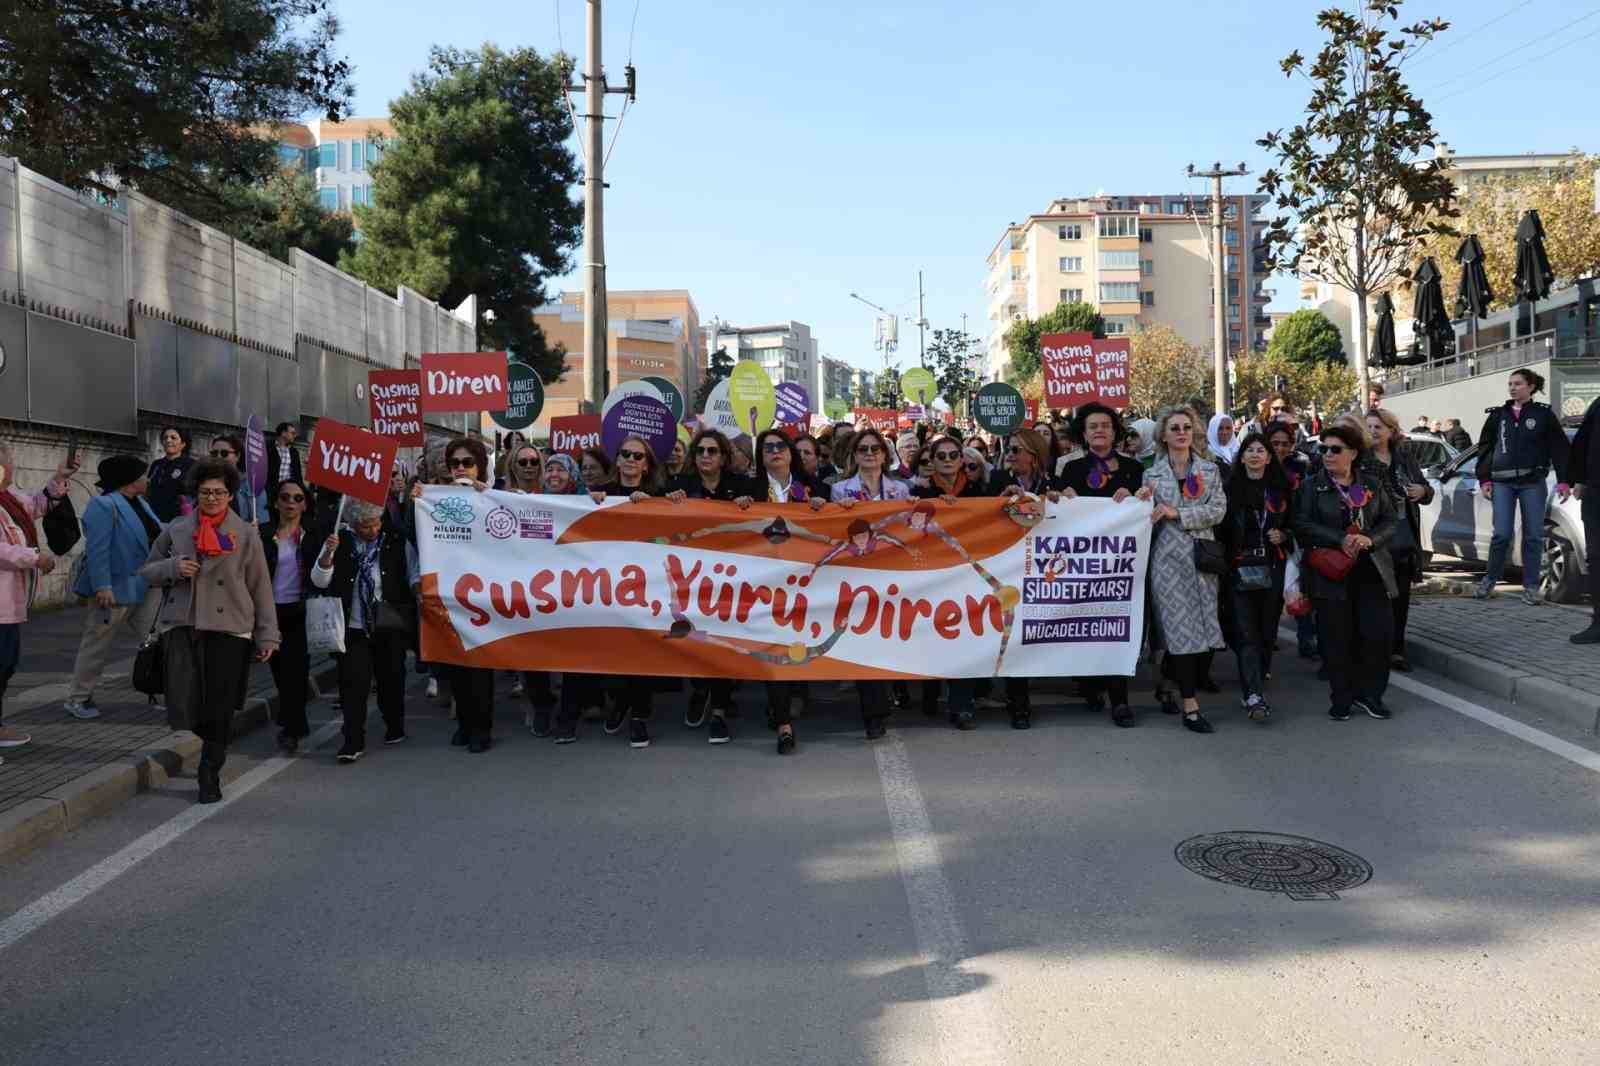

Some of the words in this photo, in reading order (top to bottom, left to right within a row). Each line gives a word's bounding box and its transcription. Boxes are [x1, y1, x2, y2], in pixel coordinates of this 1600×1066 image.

[1043, 345, 1093, 362] Susma
[1048, 358, 1092, 378] Yürü
[1096, 363, 1125, 380] ürü
[371, 383, 420, 401] Susma
[427, 370, 502, 396] Diren
[1047, 379, 1095, 396] Diren
[376, 398, 417, 417] Yürü
[374, 418, 420, 435] Diren
[553, 430, 600, 450] Diren
[320, 440, 382, 483] Yürü
[1035, 536, 1137, 554] KADINA
[1034, 554, 1136, 576] YÖNELİK
[454, 564, 662, 627] Susma,
[667, 553, 822, 638] Yürü,
[833, 581, 1003, 641] Diren
[1026, 579, 1088, 603] ŞİDDETE
[1089, 579, 1130, 600] KARŞI
[1025, 621, 1089, 641] MÜCADELE
[1090, 618, 1126, 637] GÜNÜ
